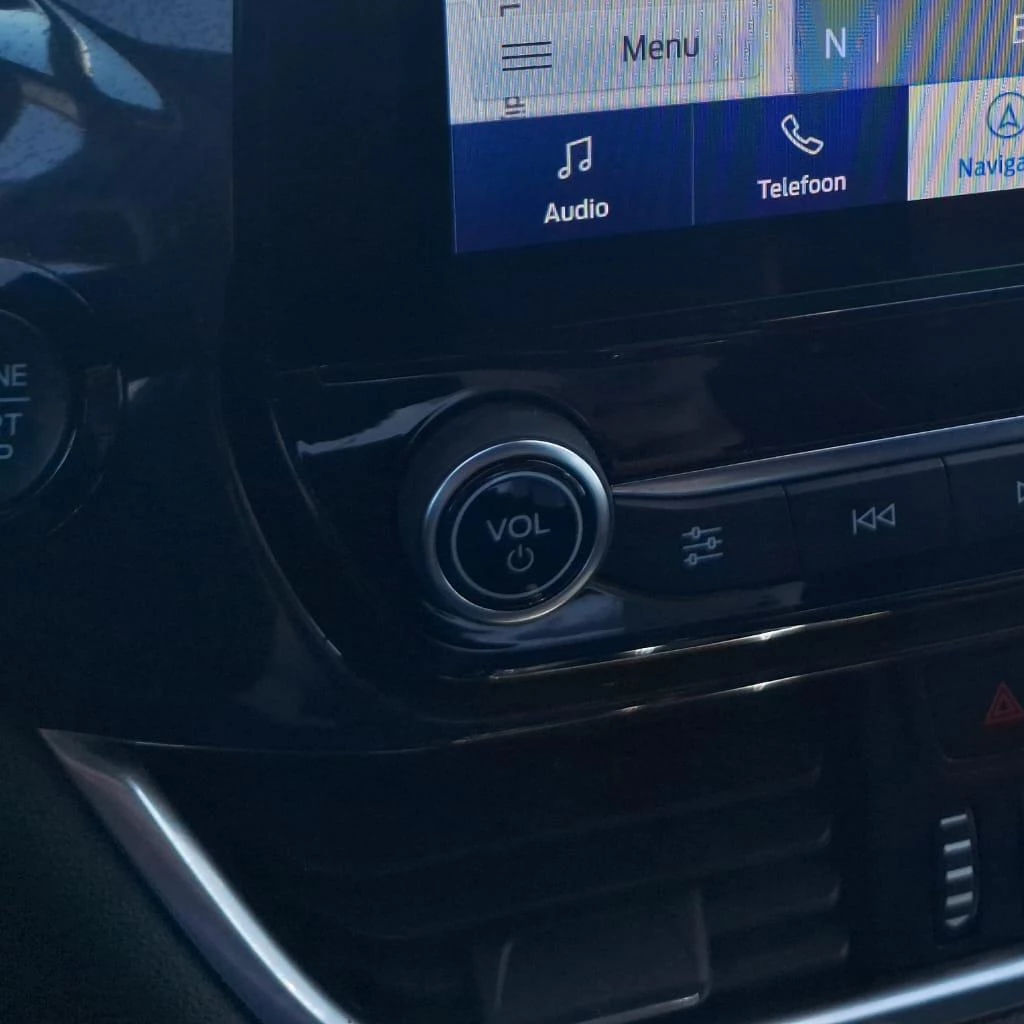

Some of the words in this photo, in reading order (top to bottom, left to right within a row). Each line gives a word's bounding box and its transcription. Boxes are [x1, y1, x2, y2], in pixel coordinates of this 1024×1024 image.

[622, 33, 701, 63] Menu
[825, 27, 846, 59] N
[757, 173, 847, 201] Telefoon
[543, 196, 610, 225] Audio
[486, 512, 551, 542] VOL
